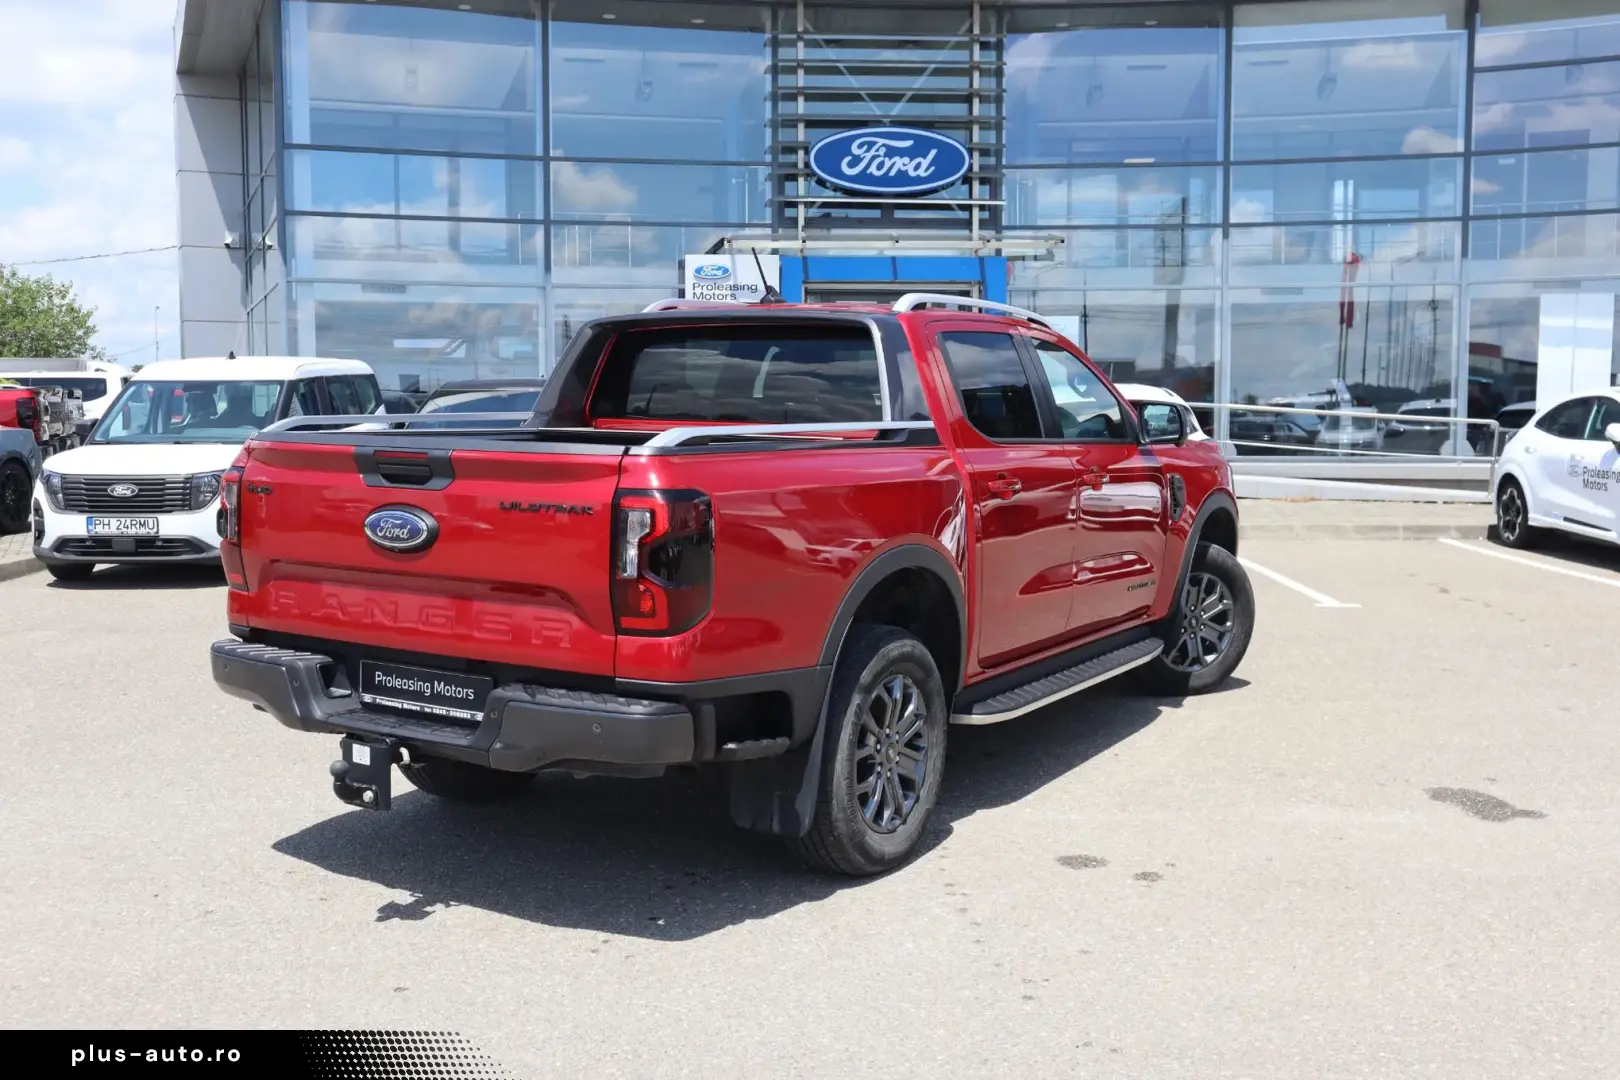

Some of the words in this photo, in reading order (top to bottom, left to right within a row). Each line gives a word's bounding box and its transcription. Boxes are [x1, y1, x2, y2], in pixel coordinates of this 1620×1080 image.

[841, 136, 938, 177] Ford
[700, 265, 723, 276] Ford
[692, 282, 758, 293] Proleasing
[692, 292, 737, 301] Motors
[1582, 465, 1620, 484] Proleasing
[1582, 478, 1608, 492] Motors
[94, 519, 111, 531] PH
[116, 519, 155, 531] 24RMU
[376, 517, 411, 539] Ford
[270, 589, 573, 648] RANGER
[375, 671, 431, 696] Proleasing
[434, 680, 475, 700] Motors
